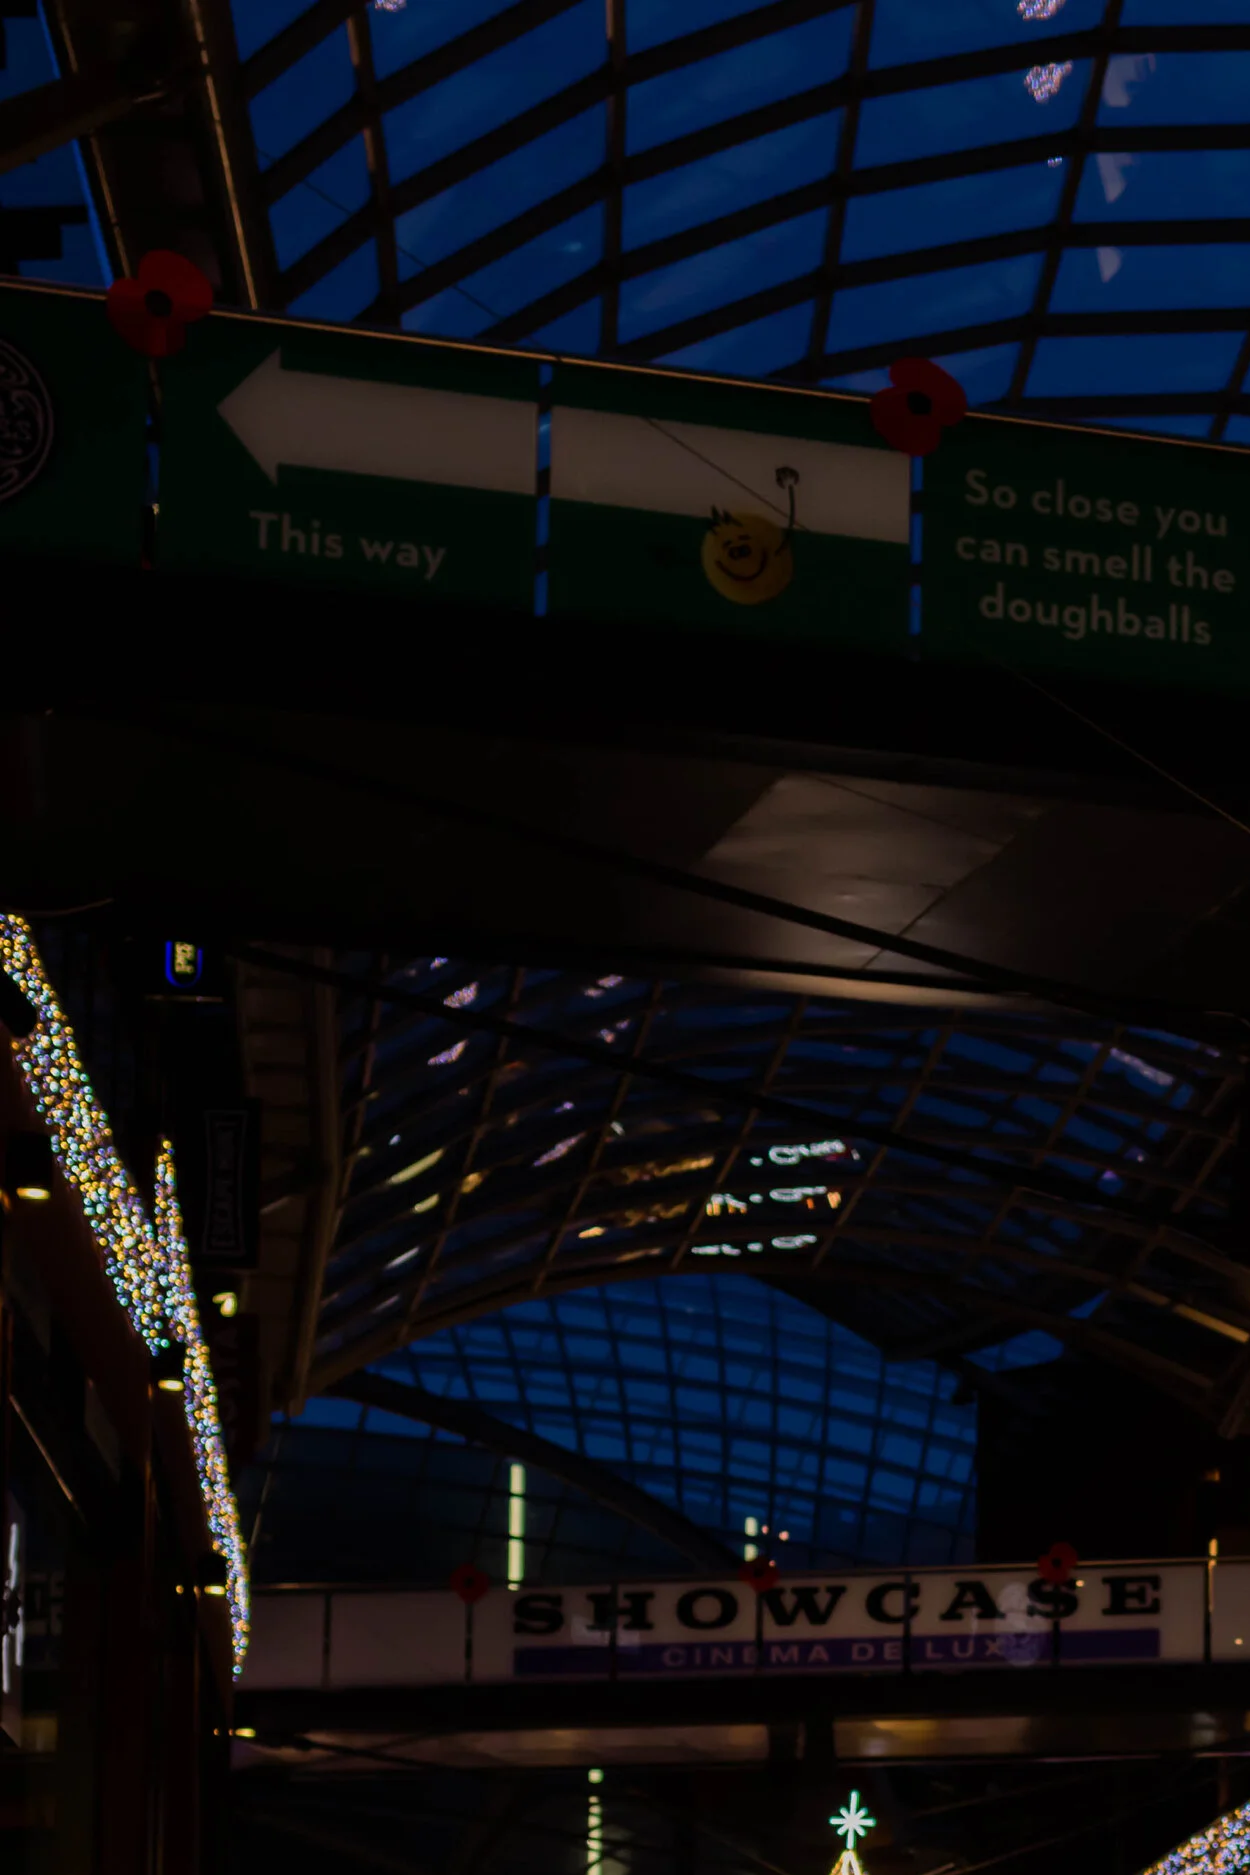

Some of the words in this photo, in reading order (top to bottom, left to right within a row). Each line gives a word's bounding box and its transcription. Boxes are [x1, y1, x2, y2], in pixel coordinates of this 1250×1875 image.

[964, 466, 1018, 510] So
[1031, 477, 1140, 527] close
[1154, 504, 1229, 541] you
[248, 508, 345, 561] This
[358, 536, 449, 583] way
[954, 535, 1030, 569] can
[1041, 541, 1154, 584] smell
[1165, 549, 1237, 595] the
[977, 580, 1213, 647] doughballs
[514, 1576, 1160, 1634] SHOWCASE
[662, 1643, 831, 1668] CINEMA
[851, 1641, 902, 1662] DE
